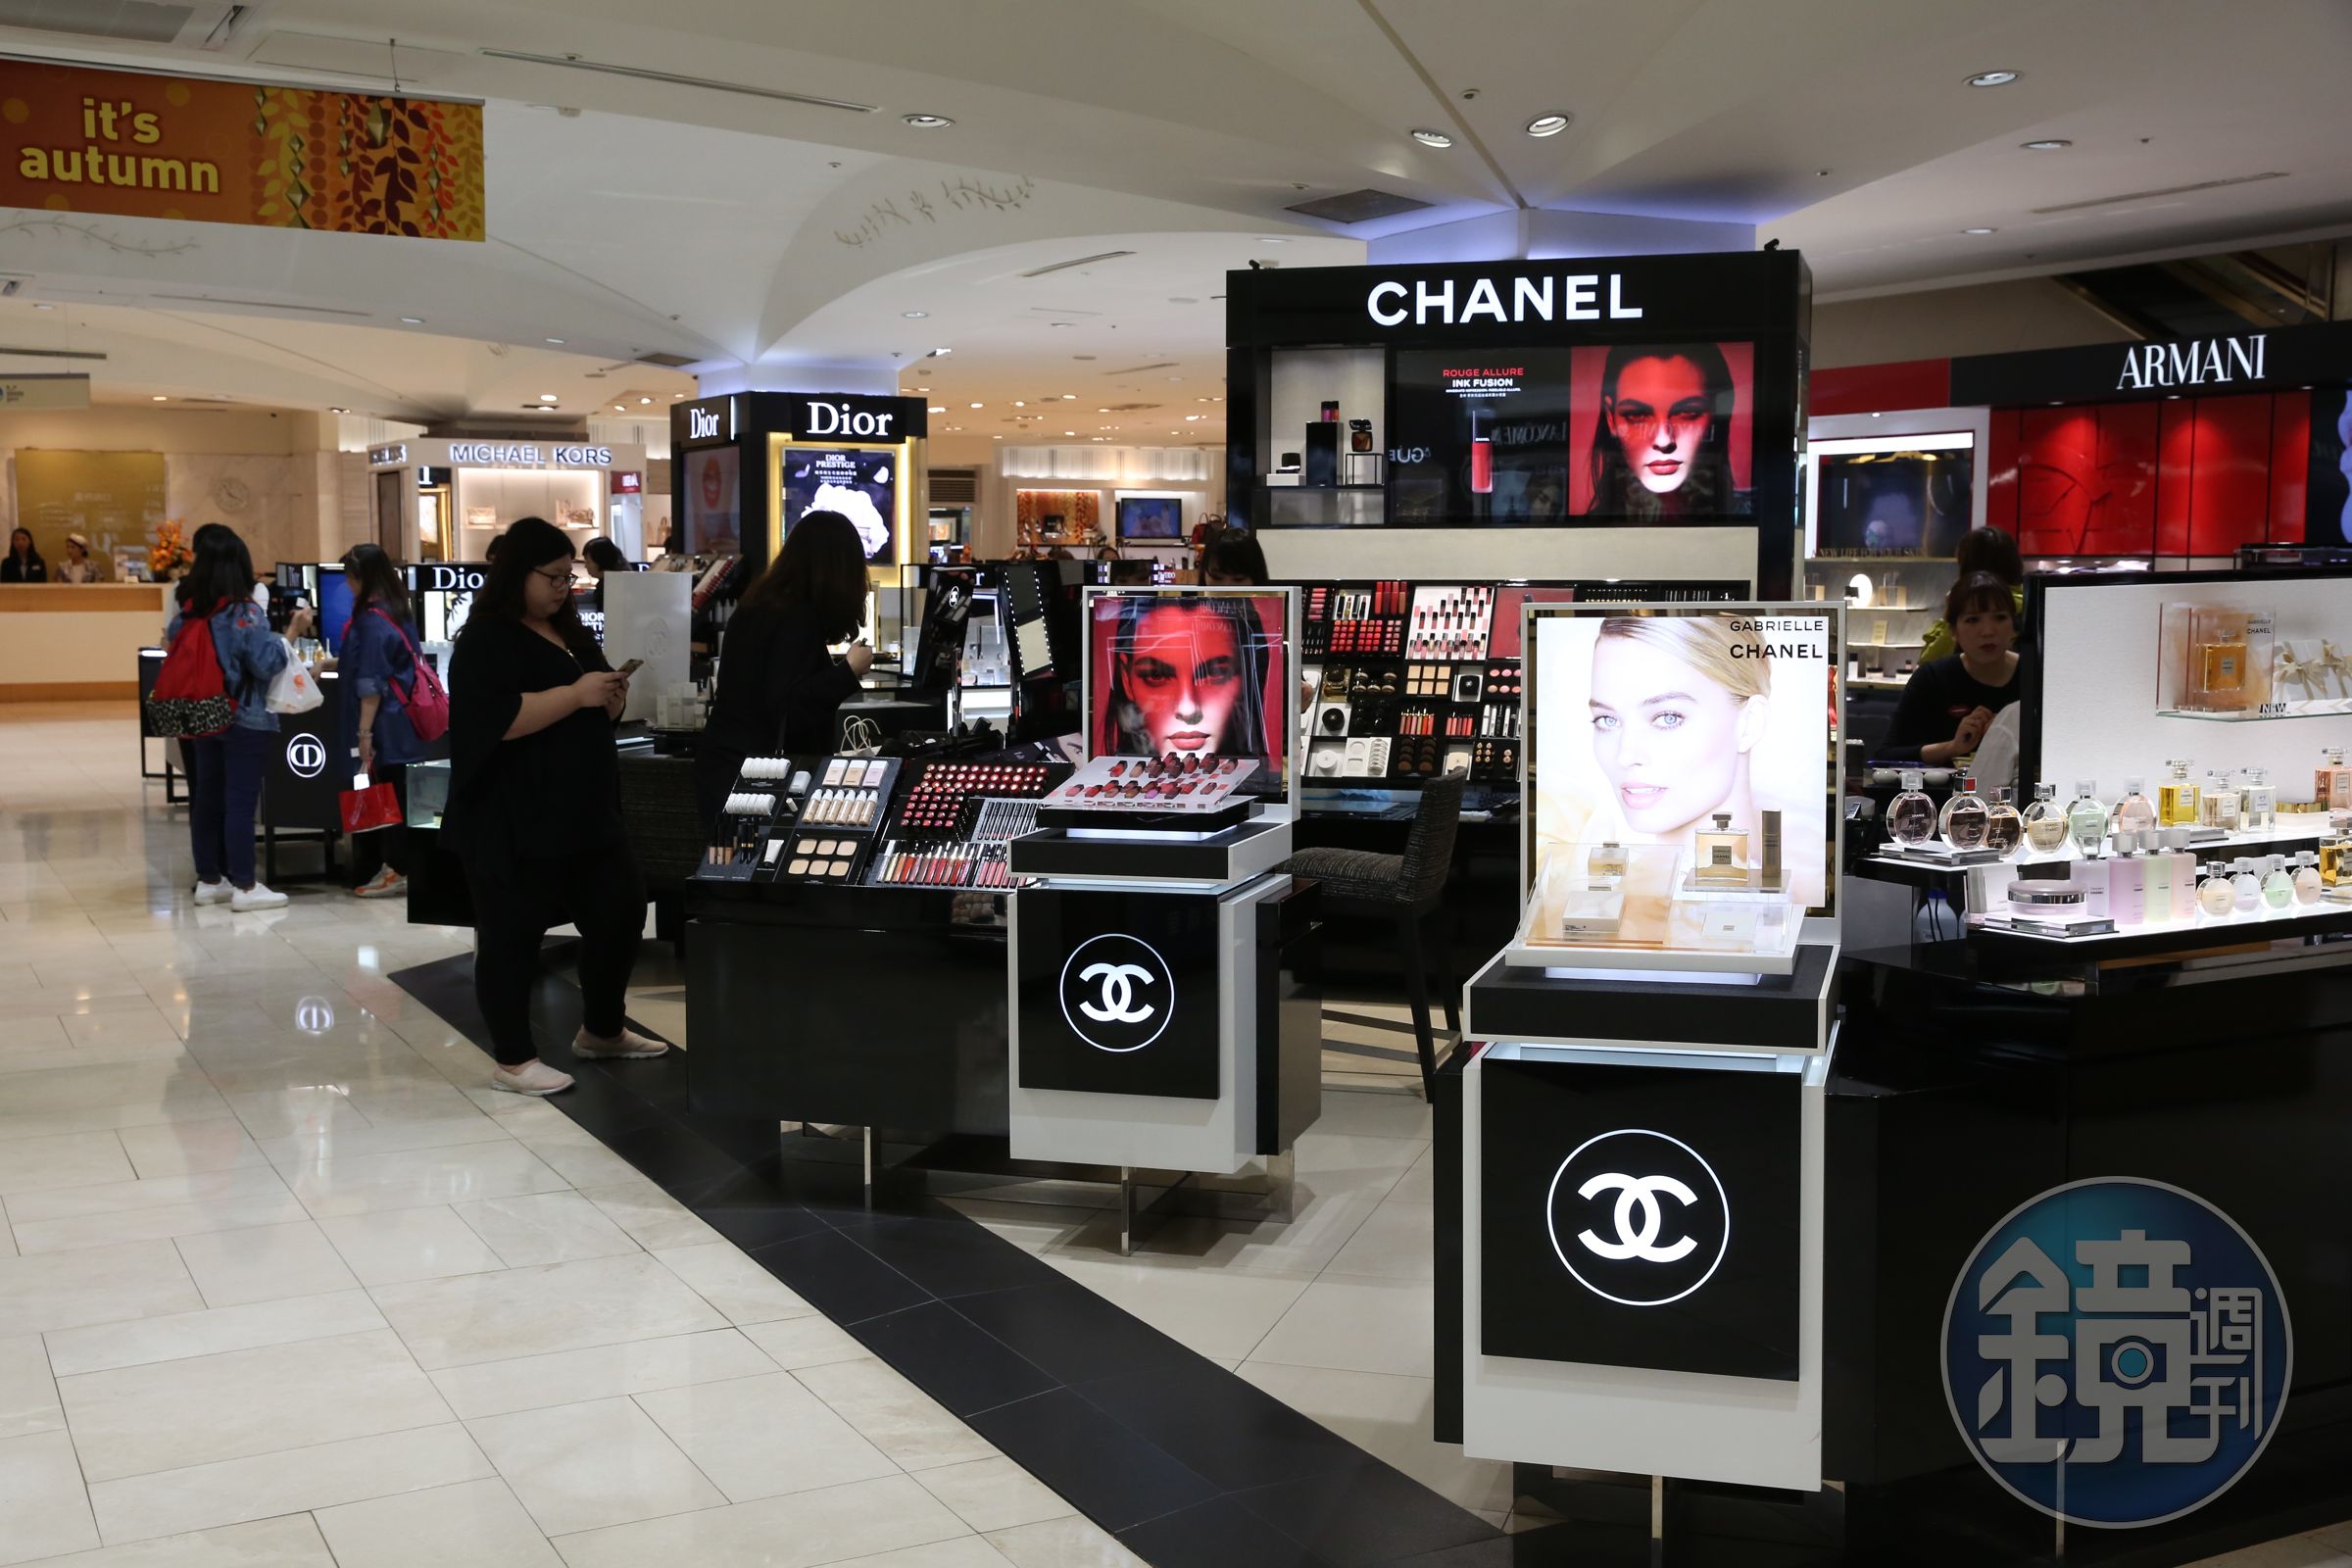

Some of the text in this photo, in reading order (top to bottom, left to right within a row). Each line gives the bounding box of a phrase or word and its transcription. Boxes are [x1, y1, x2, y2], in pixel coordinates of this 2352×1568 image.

[82, 97, 161, 144] it's
[19, 145, 220, 193] autumn
[1367, 273, 1642, 326] CHANEL
[1482, 368, 1524, 376] ALLURE
[2116, 334, 2268, 390] ARMANI
[1452, 377, 1513, 388] INK FUSION
[689, 408, 719, 440] Dior
[806, 401, 894, 436] Dior
[450, 444, 612, 465] MICHAEL KORS
[815, 460, 857, 469] PRESTIGE
[432, 566, 488, 590] Dio
[1730, 620, 1824, 632] GABRIELLE
[1730, 643, 1824, 660] CHANEL
